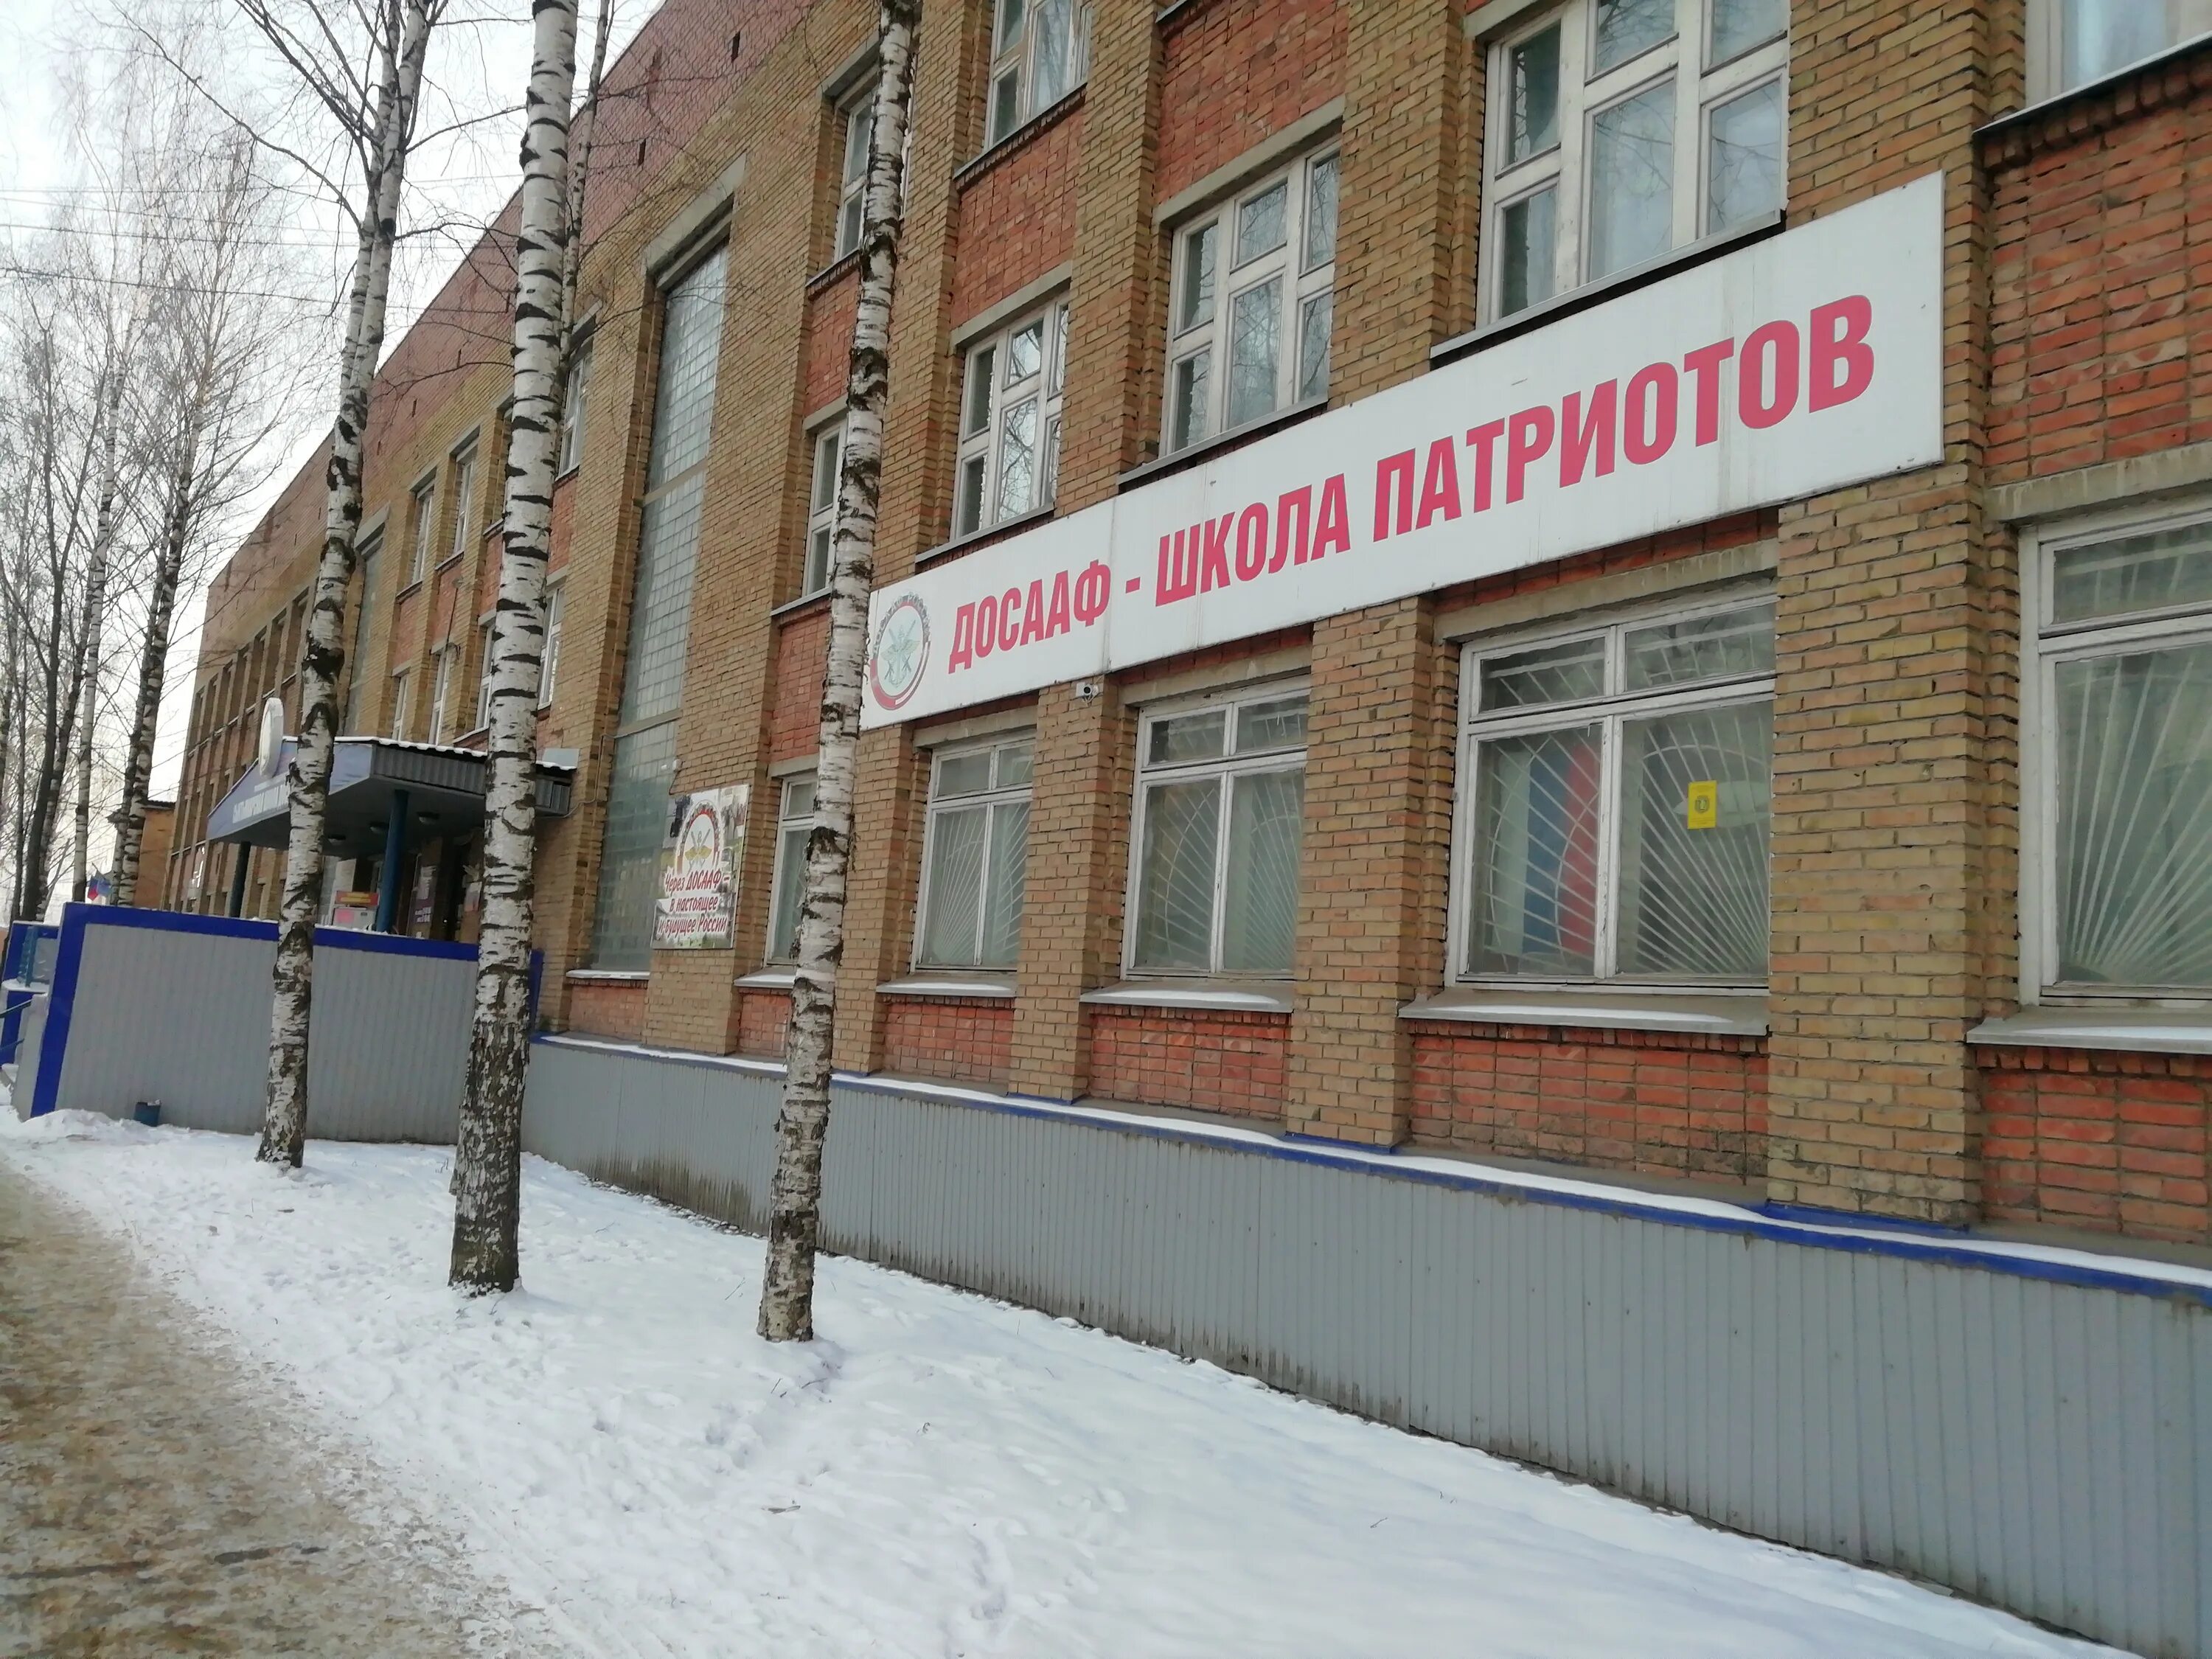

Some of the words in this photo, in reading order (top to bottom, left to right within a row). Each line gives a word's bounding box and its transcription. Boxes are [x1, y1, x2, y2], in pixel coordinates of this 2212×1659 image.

[948, 560, 1111, 674] ДОСААФ
[1125, 577, 1141, 594] -
[1155, 473, 1352, 608] ШКОЛА
[1372, 295, 1875, 543] ПАТРИОТОВ
[665, 873, 685, 897] Через
[686, 869, 722, 891] ДОСААФ
[669, 898, 675, 913] в
[676, 896, 718, 914] настоящее
[658, 919, 664, 933] и
[665, 919, 697, 938] будущее
[698, 914, 727, 933] России
